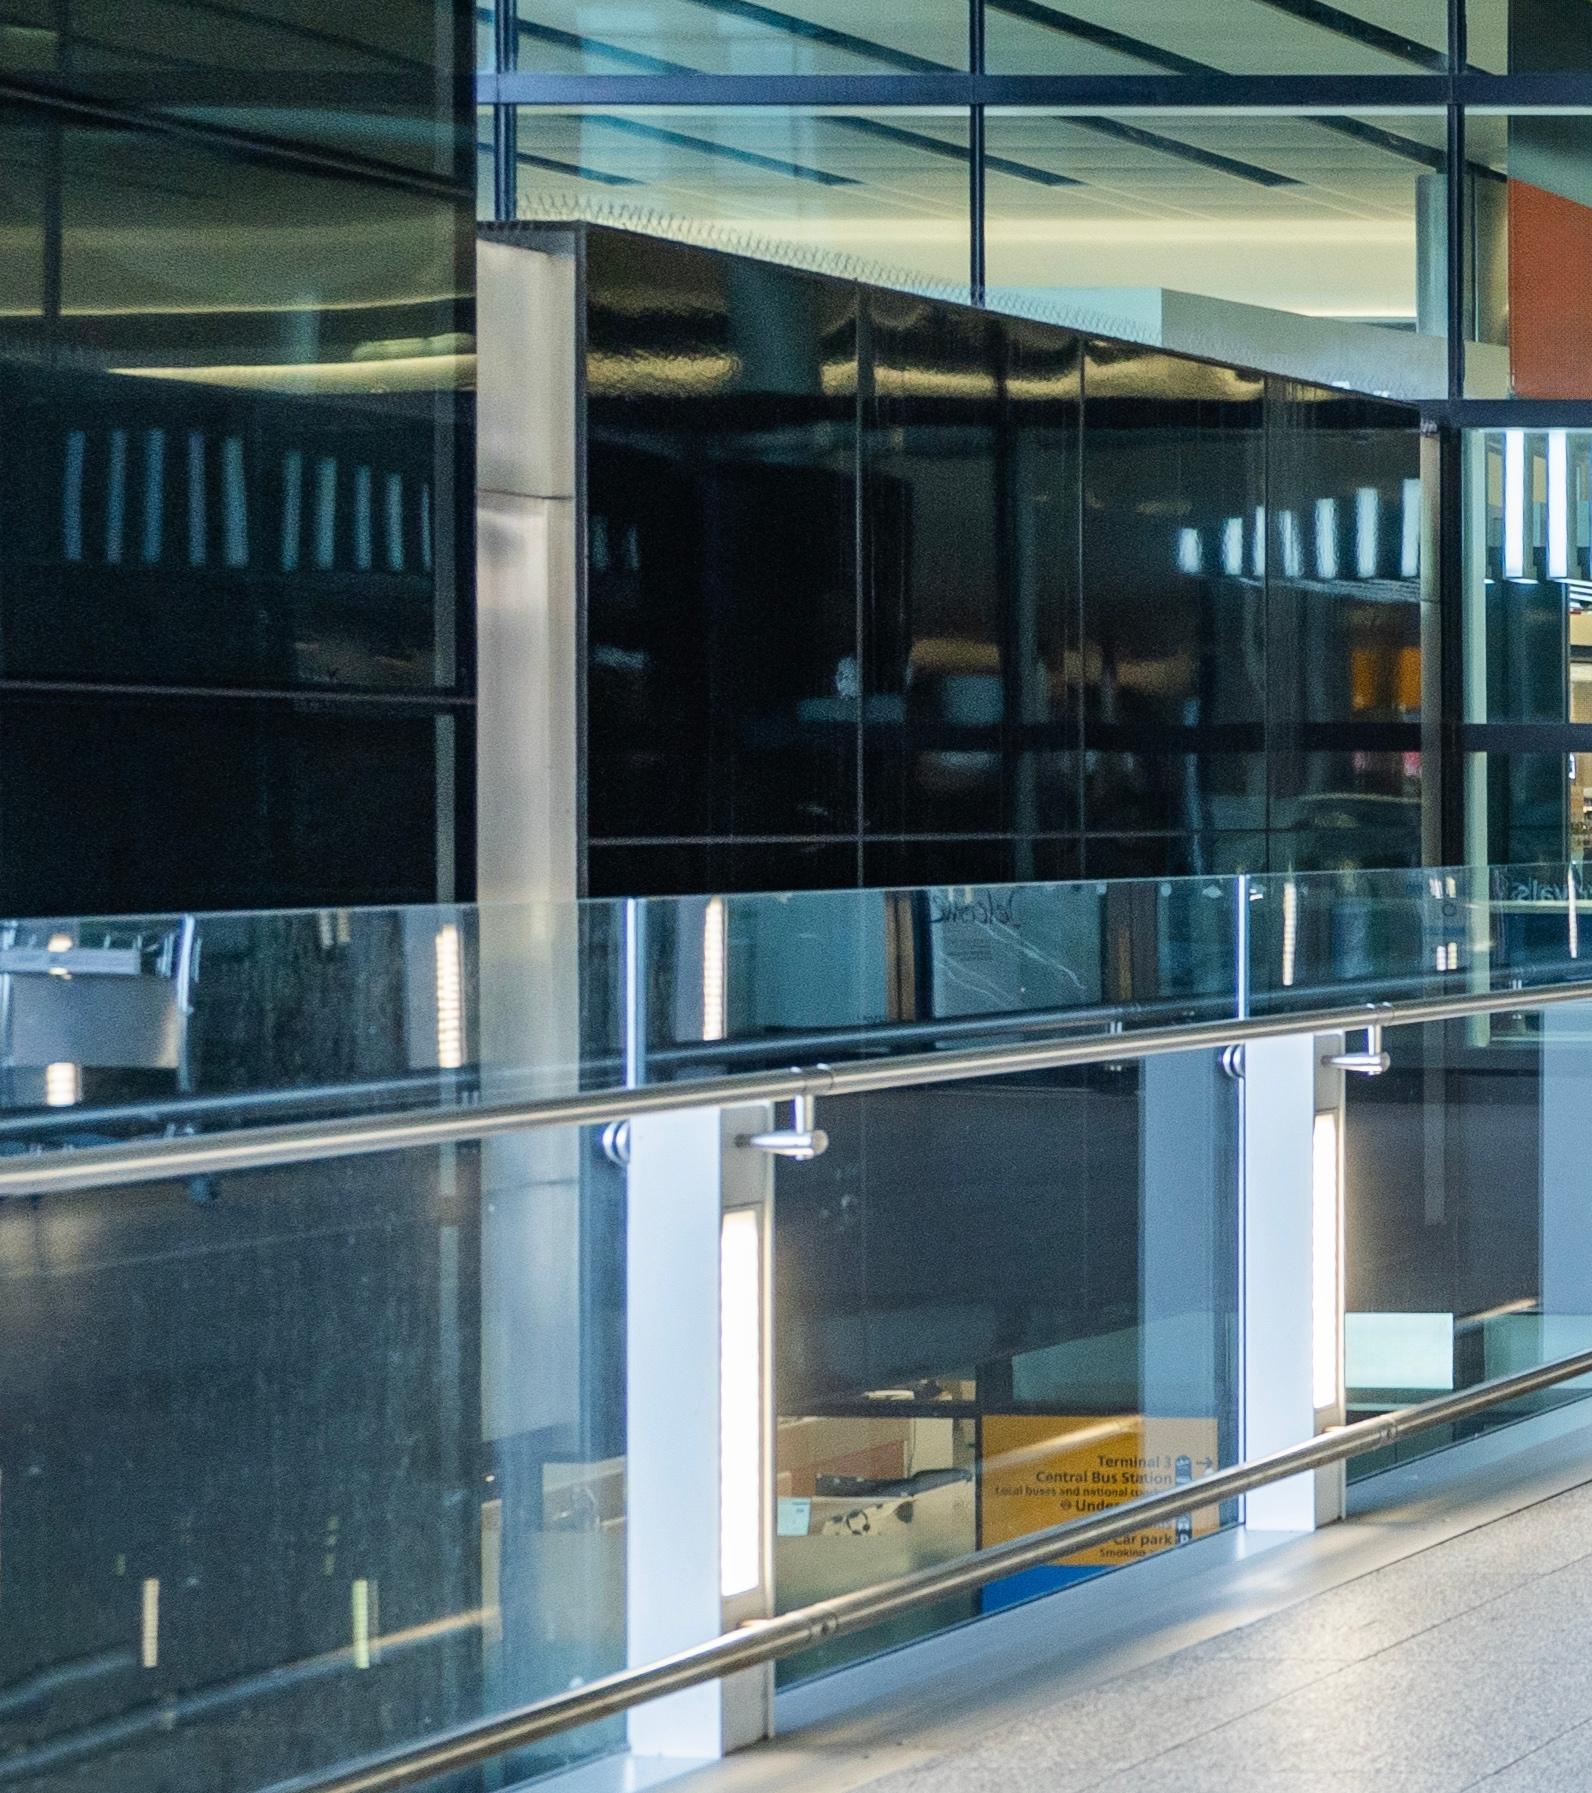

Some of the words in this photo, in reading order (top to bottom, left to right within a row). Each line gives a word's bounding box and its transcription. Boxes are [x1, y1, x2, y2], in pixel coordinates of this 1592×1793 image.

[1098, 1456, 1160, 1467] Terminal
[1036, 1471, 1088, 1483] Central
[1092, 1471, 1117, 1484] Bus
[1121, 1471, 1172, 1485] Station
[995, 1486, 1023, 1497] Local
[1060, 1486, 1080, 1497] and
[1082, 1487, 1128, 1498] national
[1140, 1534, 1172, 1549] park
